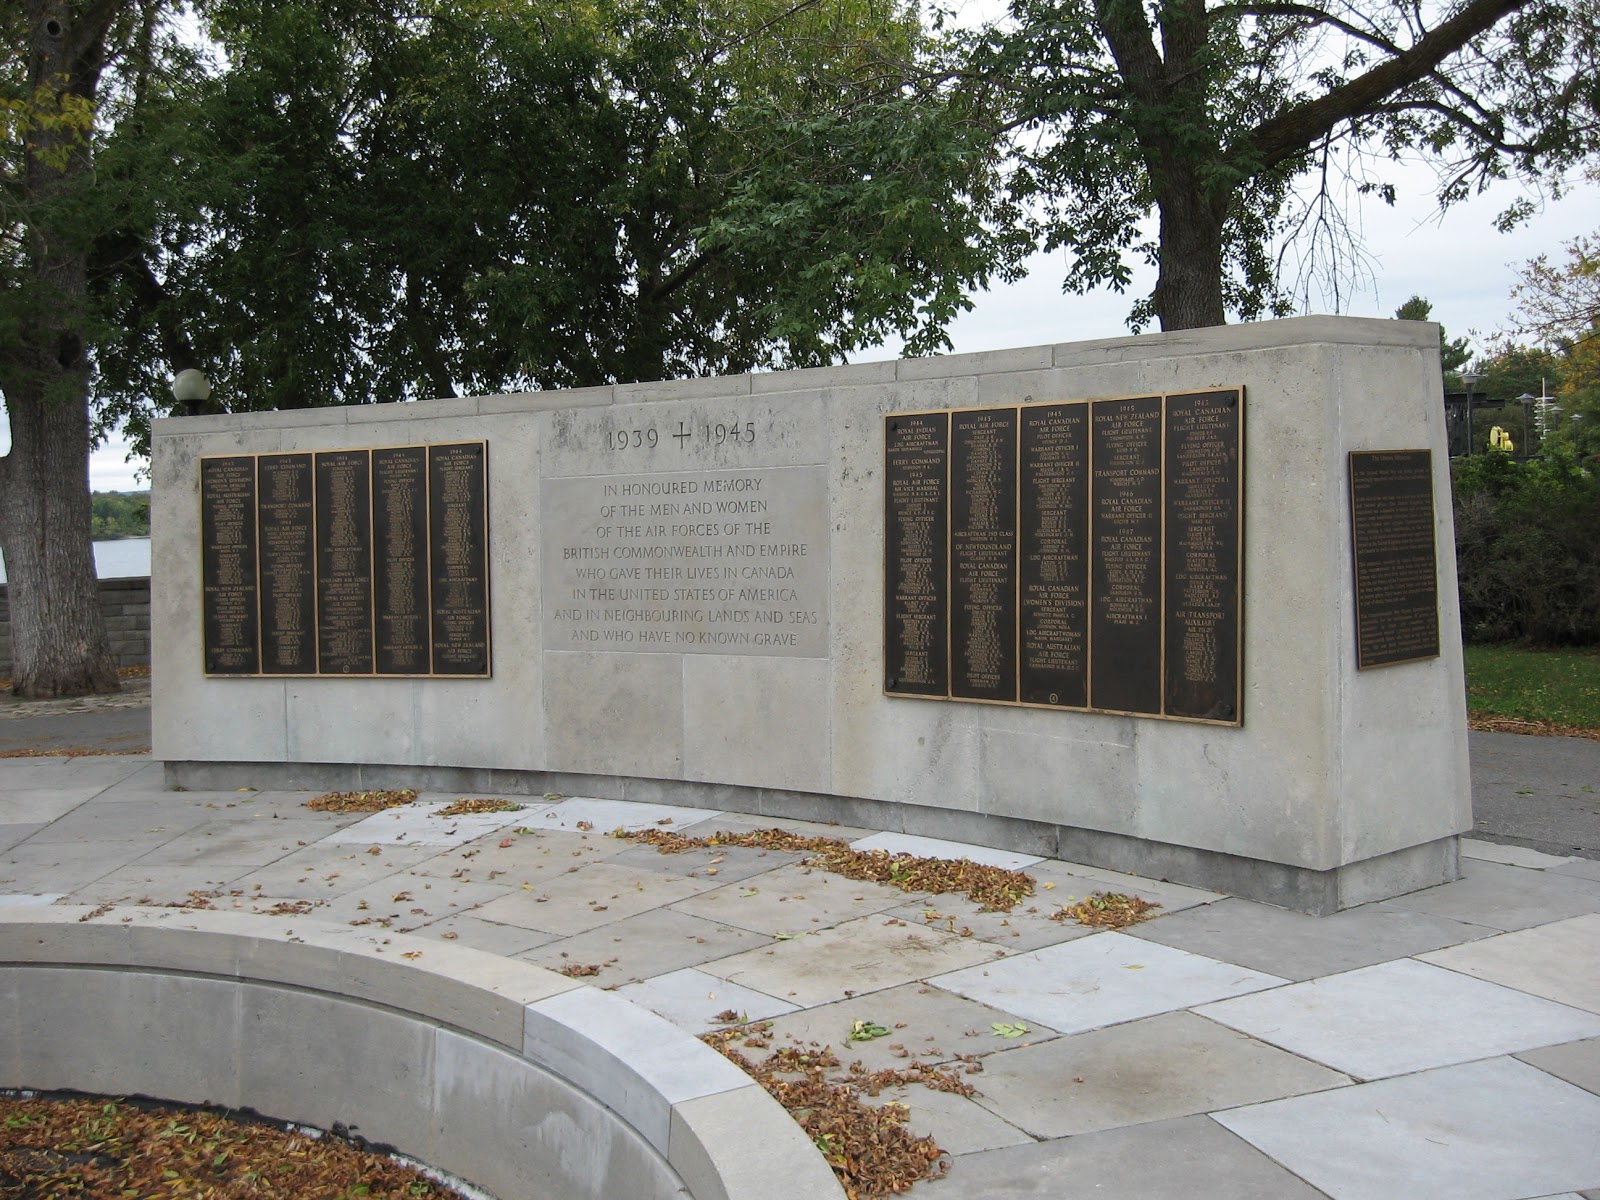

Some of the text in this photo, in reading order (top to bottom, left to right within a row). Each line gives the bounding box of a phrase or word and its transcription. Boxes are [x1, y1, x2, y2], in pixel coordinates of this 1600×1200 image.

[1130, 412, 1160, 420] ZEALAND
[1173, 407, 1232, 417] ROYAL CANADIAN
[1199, 415, 1219, 423] FORCE
[1048, 418, 1080, 426] CANADIAN
[607, 428, 659, 451] 1939
[705, 422, 756, 445] 1945
[604, 478, 762, 497] IN HONOURED MEMORY
[600, 500, 767, 517] OF THE MEN AND WOMEN
[596, 522, 771, 538] OF THE AIR FORCES OF THE
[563, 544, 807, 560] BRITISH COMMONWEALTH AND EMPIRE
[576, 566, 794, 580] WHO GAVE THEIR LIVES IN CANADA
[573, 588, 798, 601] IN THE UNITED STATES OF AMERICA
[554, 609, 818, 624] AND IN NEIGHBOURING LANDS AND SEAS
[571, 630, 797, 646] AND WHO HAVE NO KNOWN GRAVE
[1046, 643, 1081, 651] AUSTRALIAN
